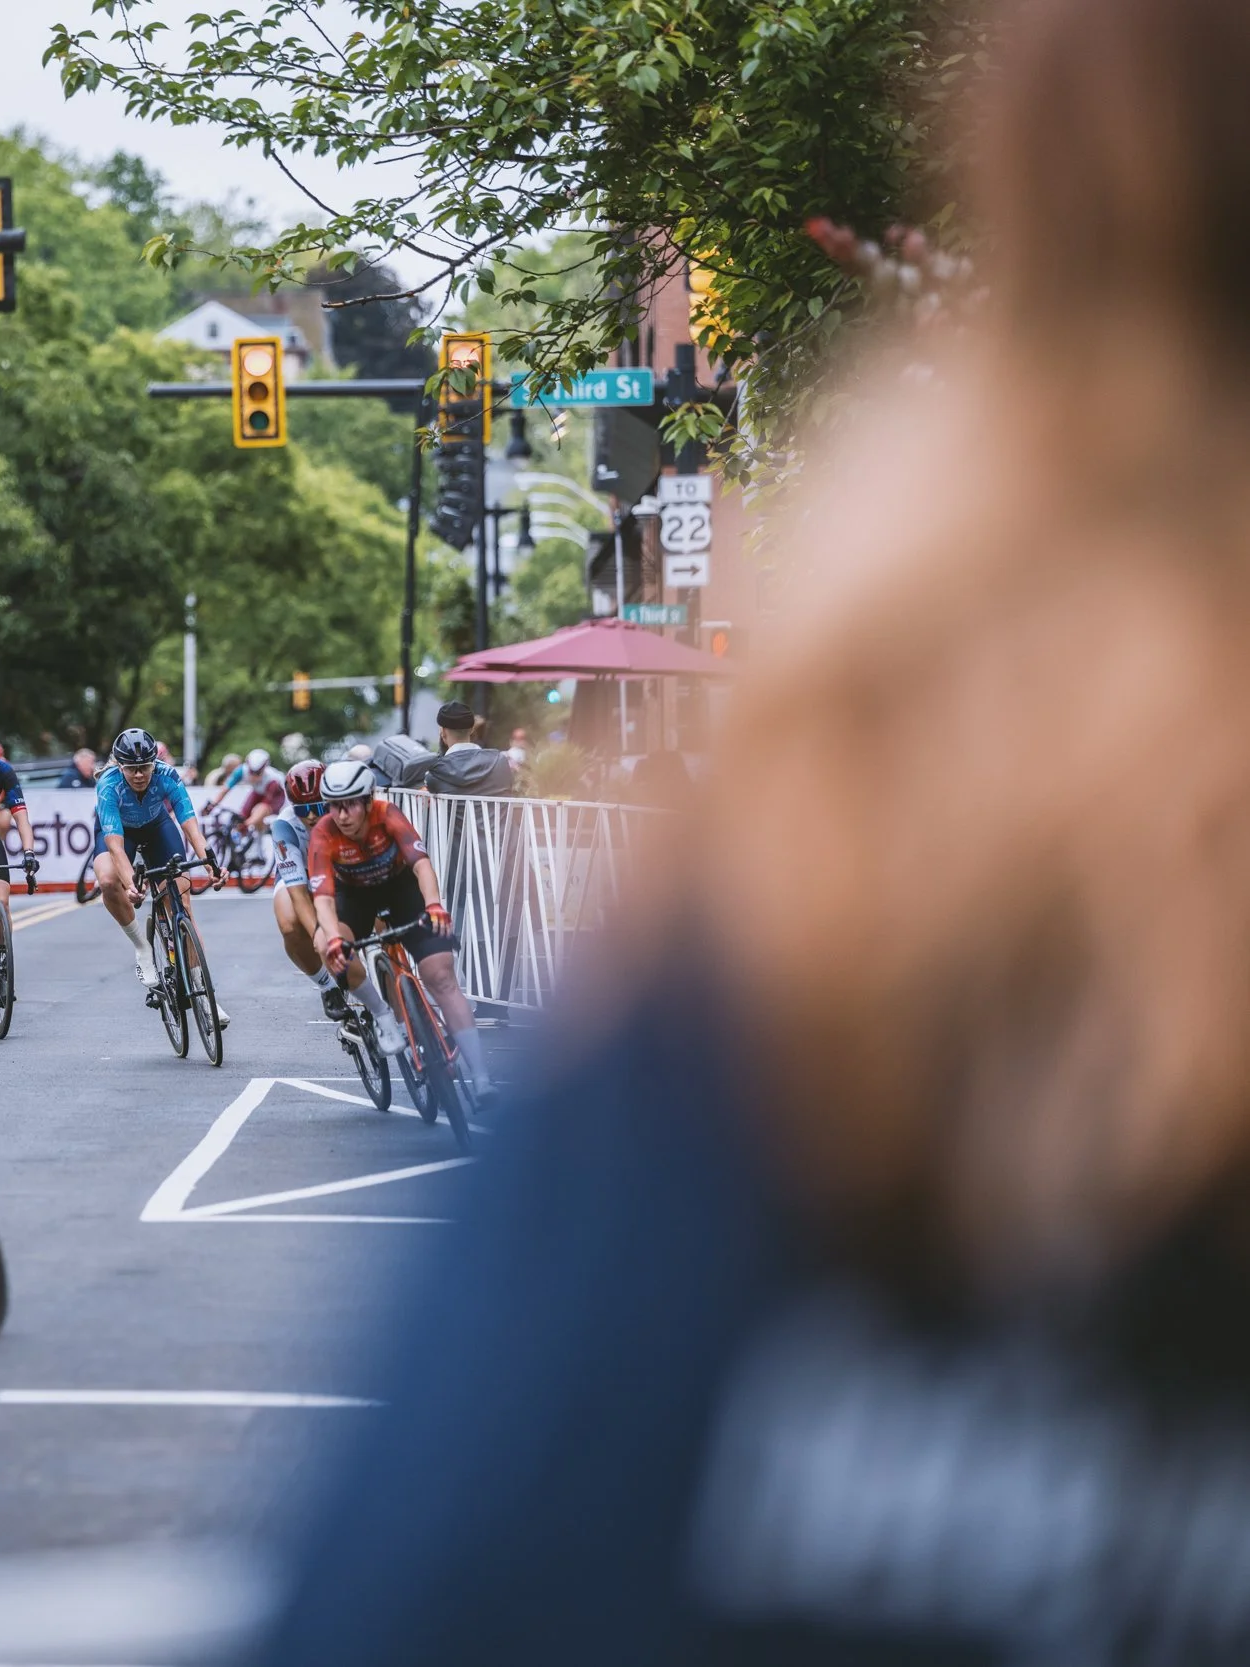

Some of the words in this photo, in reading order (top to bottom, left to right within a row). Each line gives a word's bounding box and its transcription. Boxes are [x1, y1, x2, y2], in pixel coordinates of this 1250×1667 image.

[616, 374, 641, 399] St
[675, 483, 698, 497] TO
[667, 515, 706, 541] 22
